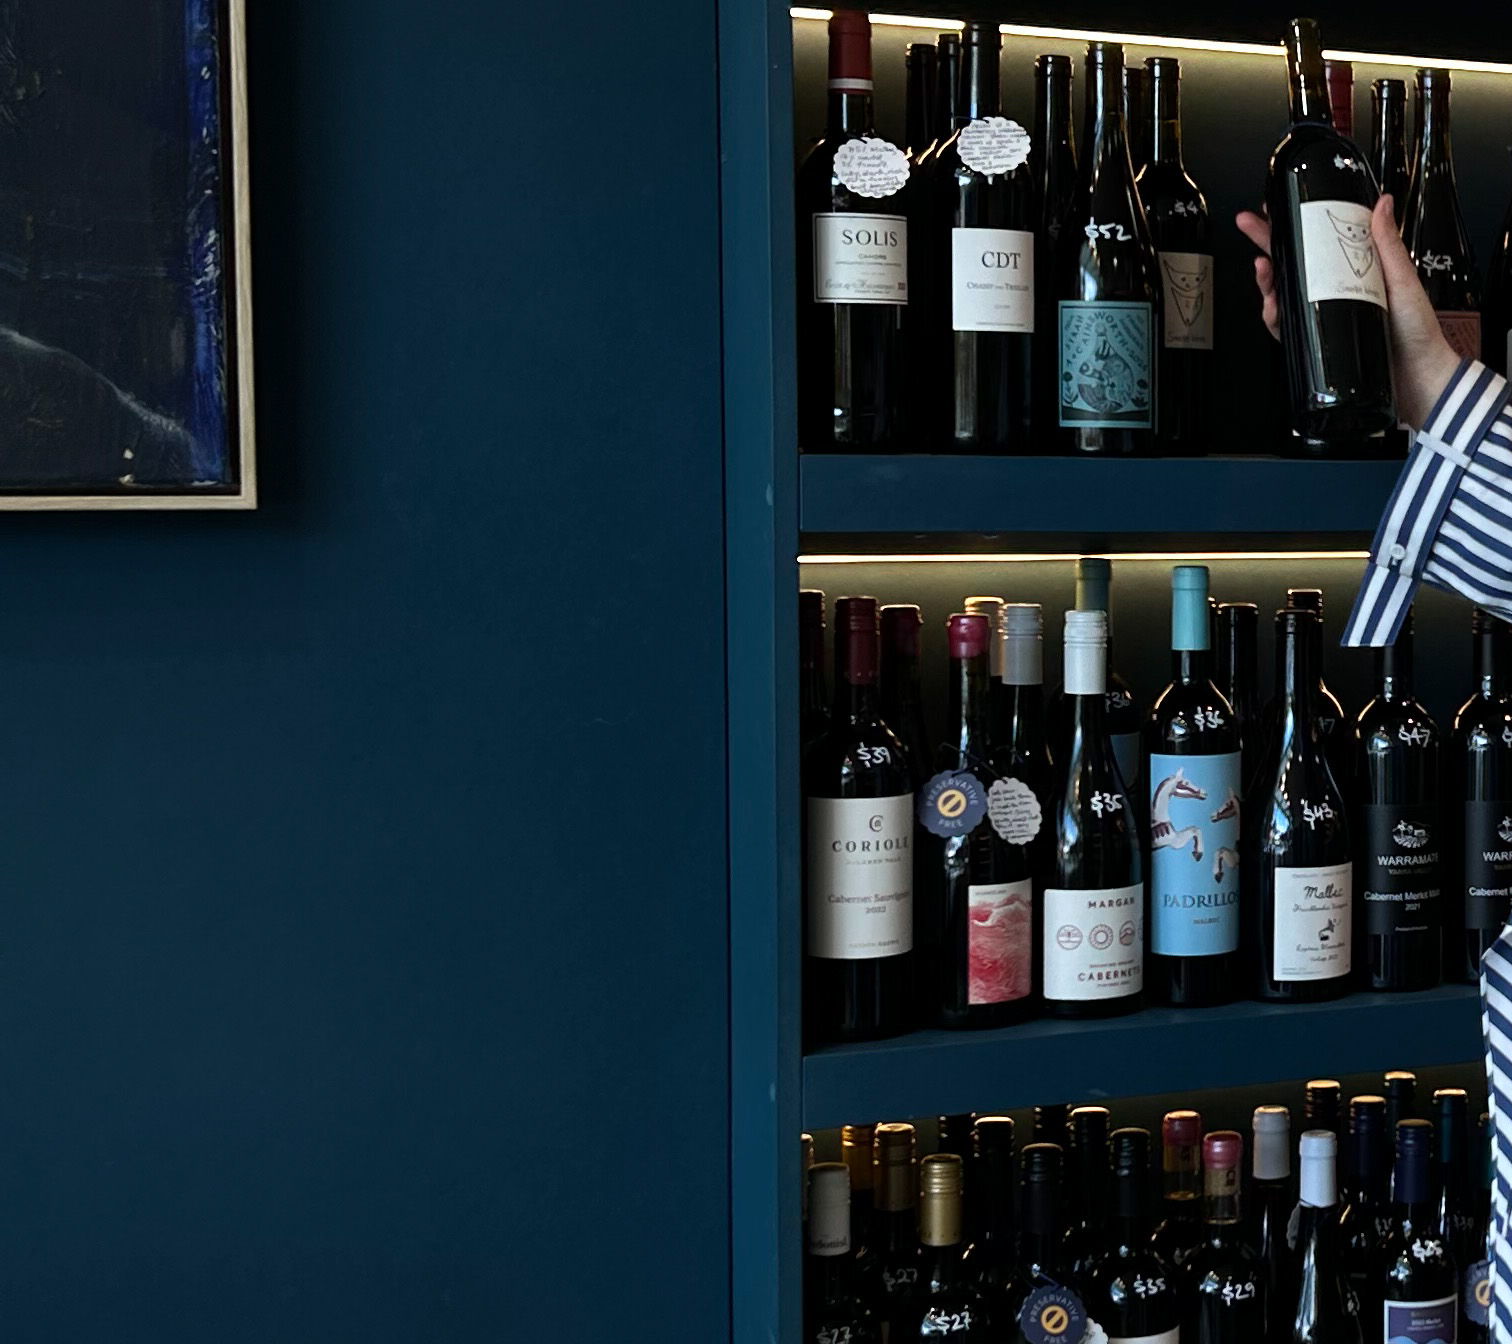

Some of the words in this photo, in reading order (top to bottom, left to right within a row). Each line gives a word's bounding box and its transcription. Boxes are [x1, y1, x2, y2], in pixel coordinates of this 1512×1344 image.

[841, 228, 899, 249] SOLIS
[1084, 216, 1132, 247] $52
[981, 250, 1021, 270] CDT
[926, 777, 980, 808] PRESERVATIVE
[938, 818, 963, 828] FREE
[1162, 892, 1240, 910] PADRILLOS
[1363, 890, 1402, 902] Cabernet
[1029, 1294, 1081, 1324] PRESERVATIVE
